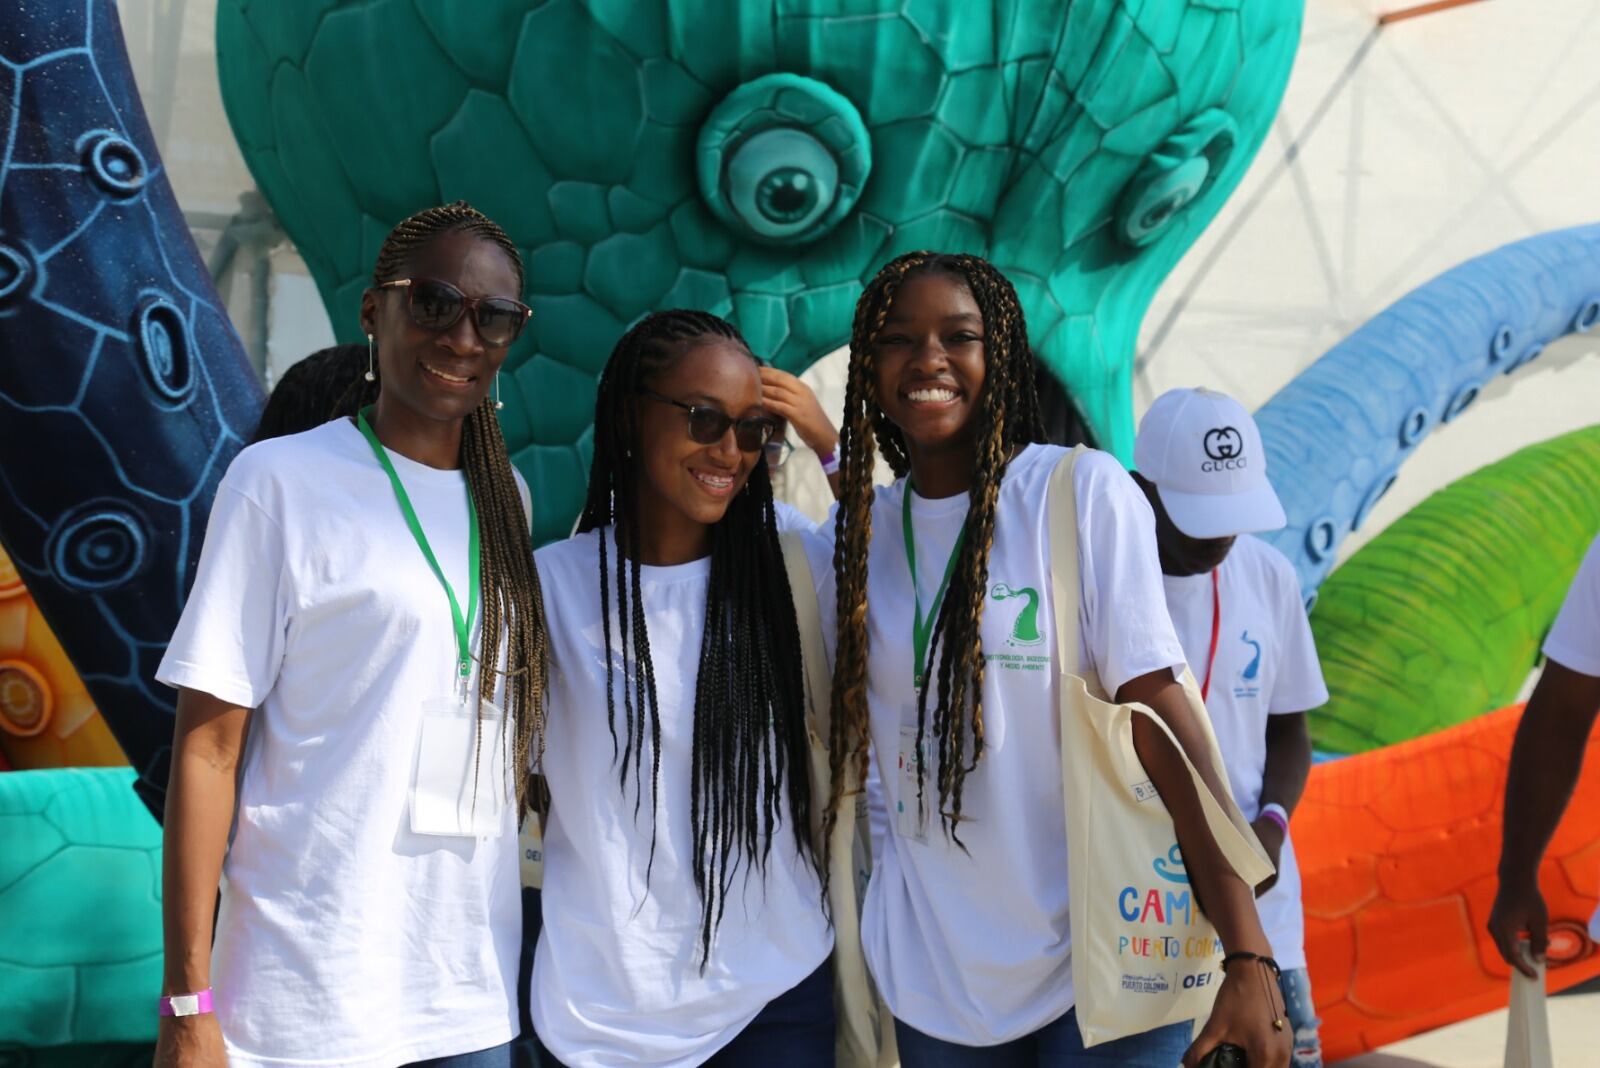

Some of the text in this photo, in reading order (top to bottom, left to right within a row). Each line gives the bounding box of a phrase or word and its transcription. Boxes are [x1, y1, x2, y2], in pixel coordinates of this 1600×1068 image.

[1201, 457, 1247, 473] GUCCI
[1119, 936, 1223, 960] PUERTO COLOM
[1183, 972, 1212, 989] OEI
